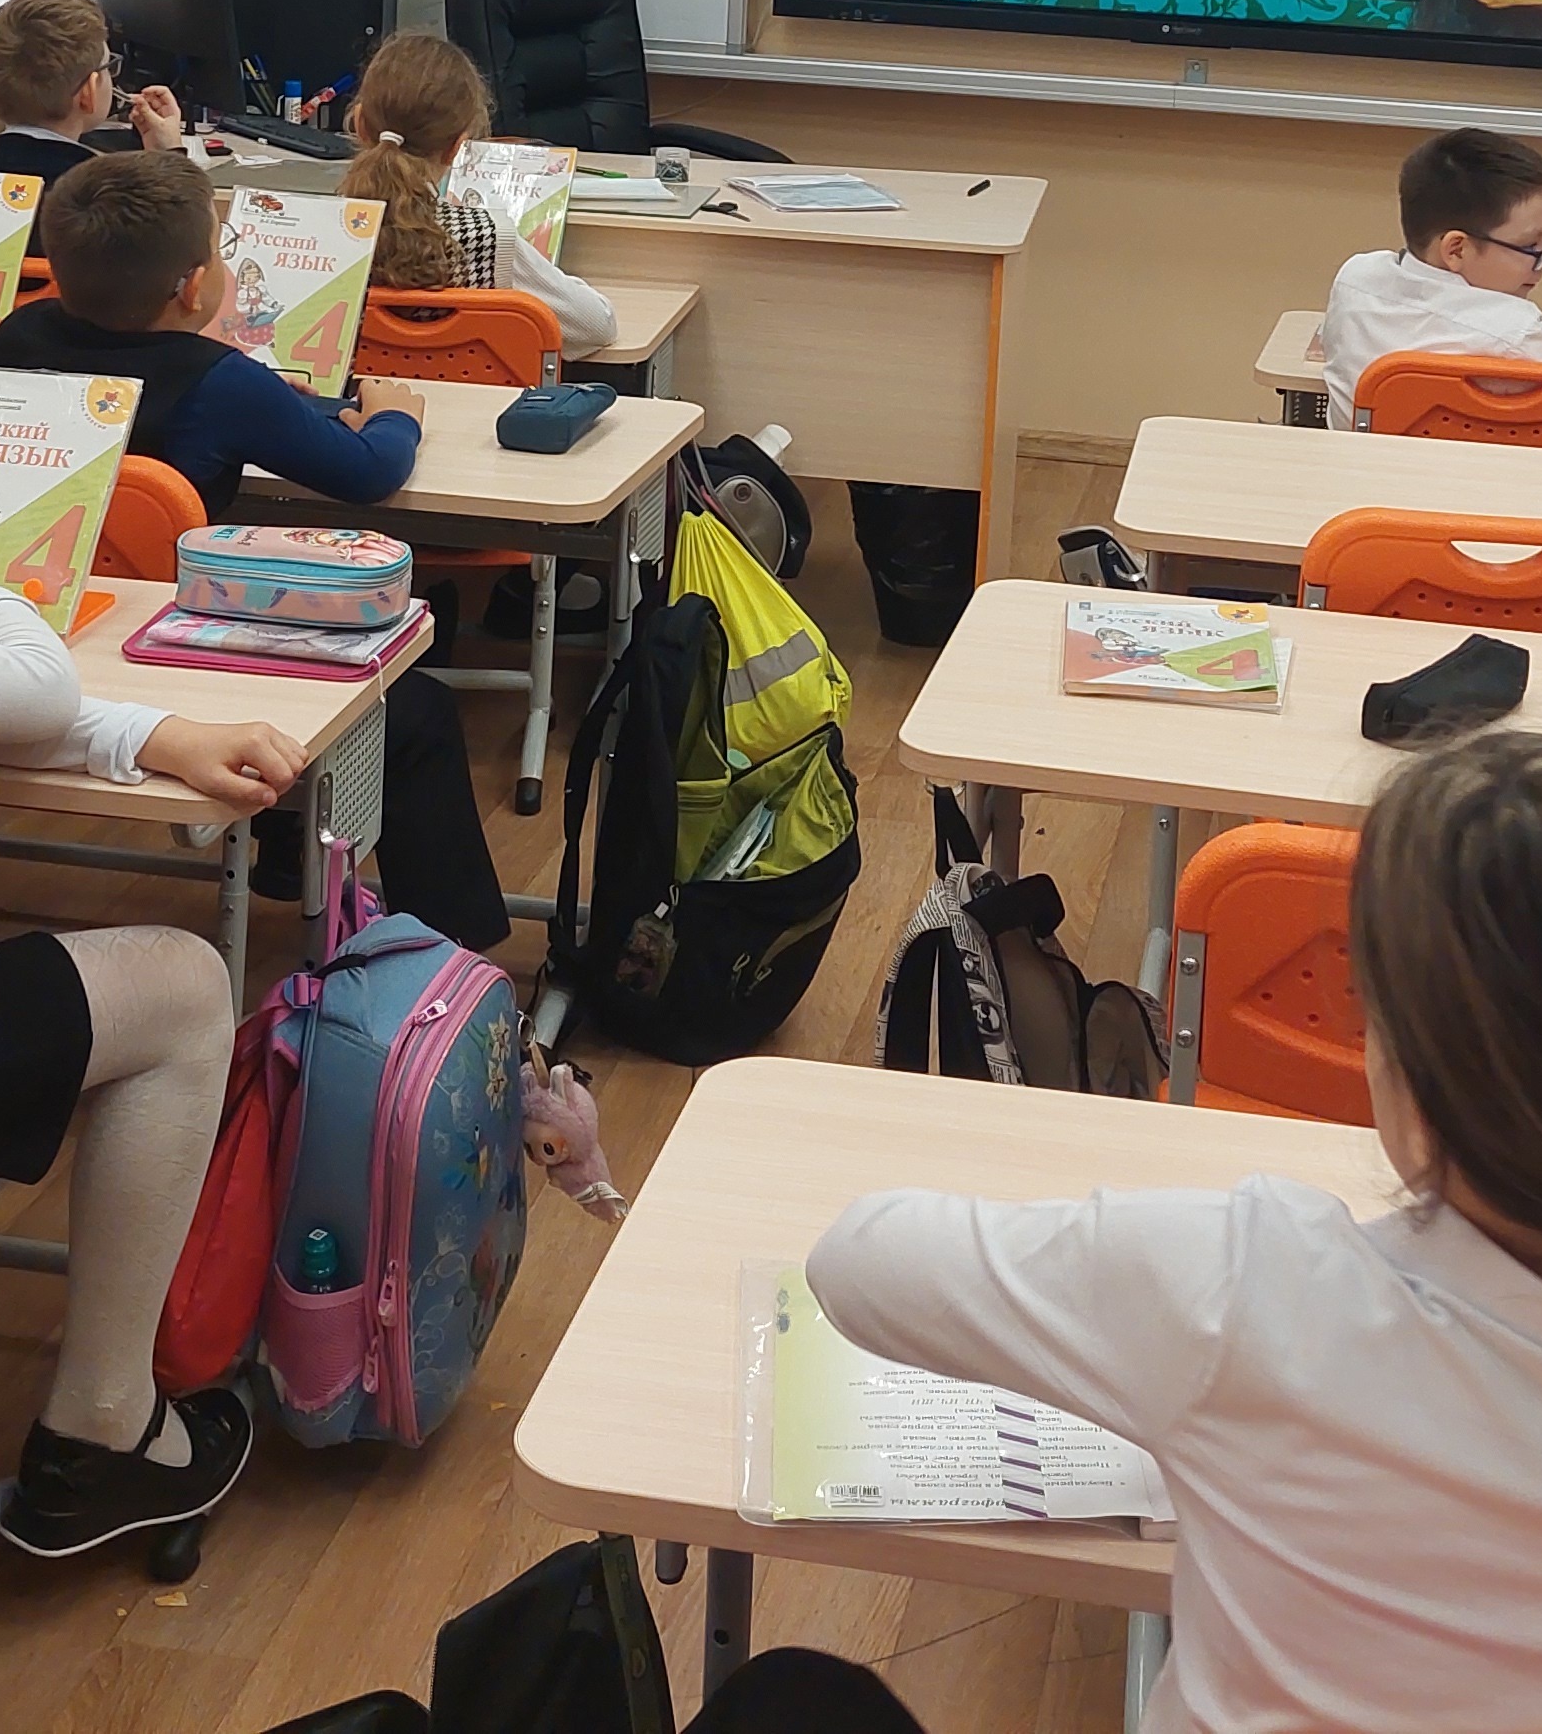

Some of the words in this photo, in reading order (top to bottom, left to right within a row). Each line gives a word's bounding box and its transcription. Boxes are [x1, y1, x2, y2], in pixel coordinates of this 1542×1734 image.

[237, 223, 319, 251] Русский
[290, 300, 349, 377] 4
[4, 505, 86, 604] 4
[890, 1496, 1006, 1508] рфограммы
